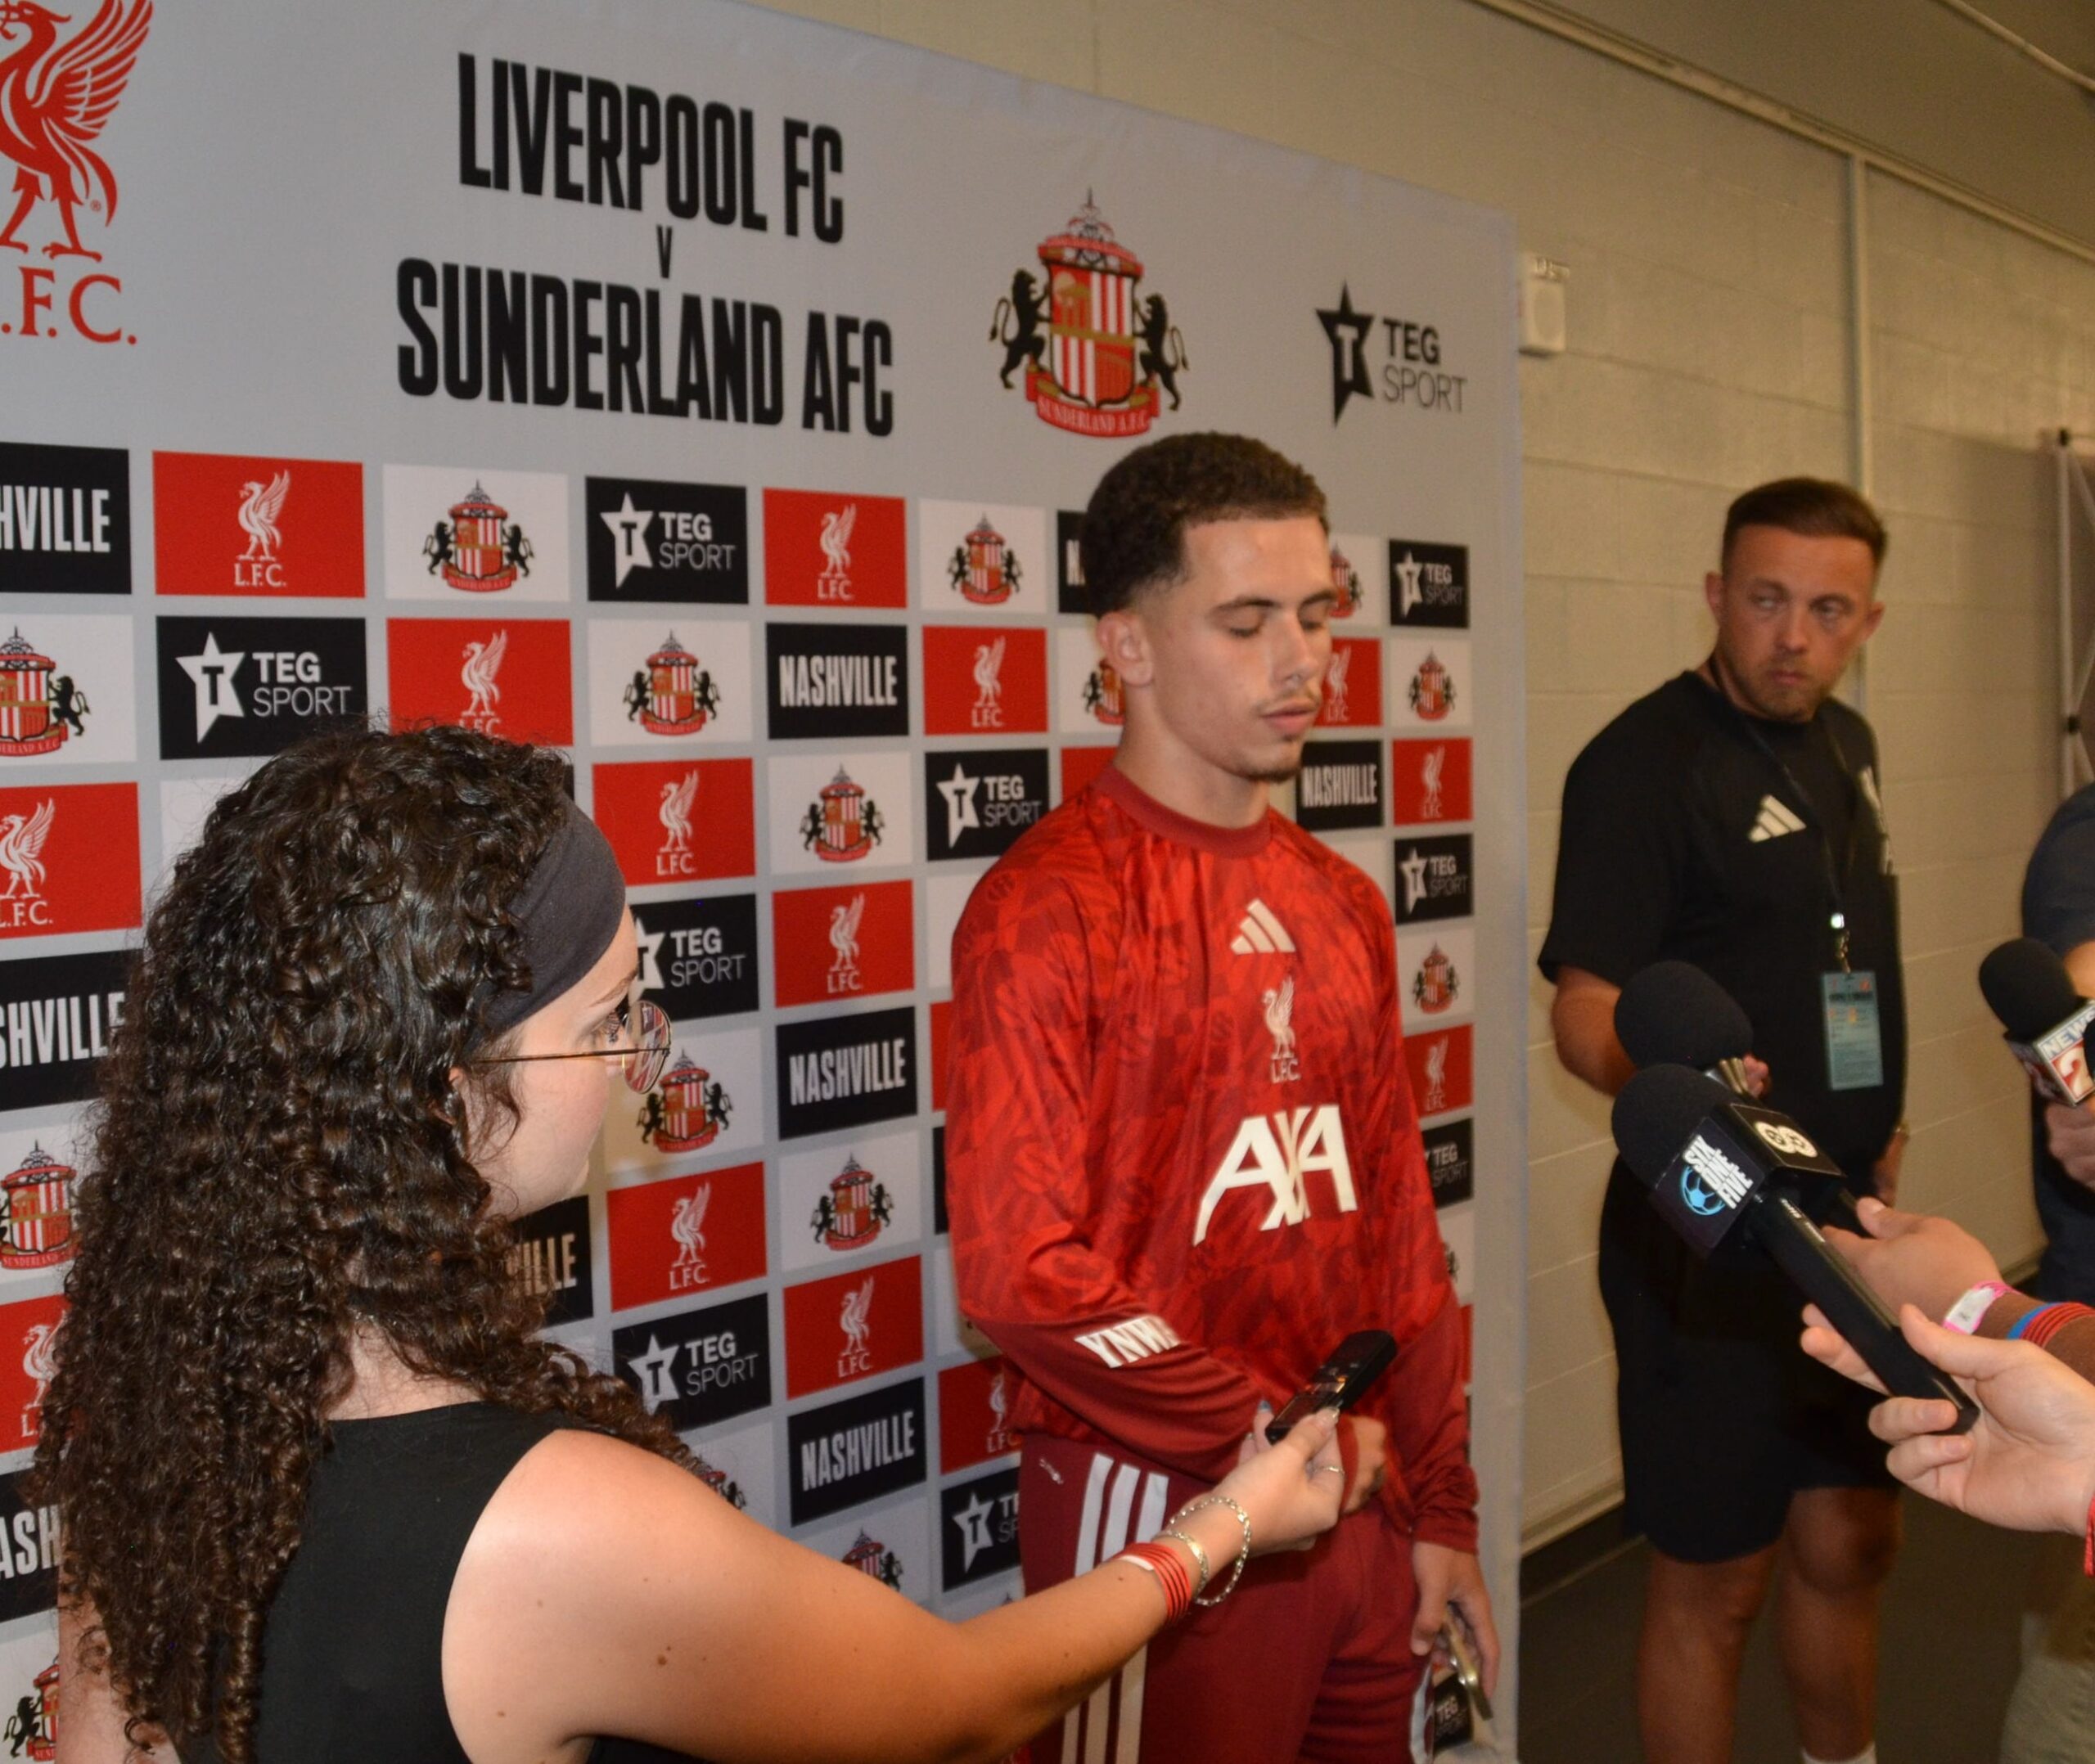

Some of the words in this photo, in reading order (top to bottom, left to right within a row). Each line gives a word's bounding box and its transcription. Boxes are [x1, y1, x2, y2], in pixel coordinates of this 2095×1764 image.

[459, 53, 767, 232] LIVERPOOL
[784, 119, 843, 244] FC
[398, 257, 783, 425] SUNDERLAND
[803, 312, 893, 437] AFC
[1382, 317, 1439, 366] TEG
[1383, 365, 1467, 412] SPORT
[659, 512, 712, 541] TEG
[660, 542, 735, 569] SPORT
[1426, 564, 1452, 583] TEG
[1426, 584, 1463, 605] SPORT
[253, 652, 320, 682] TEG
[780, 655, 897, 706] NASHVILLE
[254, 686, 351, 717] SPORT
[984, 776, 1024, 800] TEG
[1301, 764, 1376, 807] NASHVILLE
[984, 799, 1041, 827] SPORT
[1430, 856, 1456, 875] TEG
[1430, 874, 1468, 898] SPORT
[670, 927, 722, 957] TEG
[671, 953, 746, 988] SPORT
[790, 1038, 905, 1105] NASHVILLE
[1434, 1144, 1457, 1164] TEG
[1682, 1134, 1717, 1174] SIX
[1700, 1147, 1736, 1191] ONE
[1194, 1105, 1357, 1244] AXA
[1715, 1164, 1755, 1209] FIVE
[685, 1332, 736, 1366] TEG
[687, 1353, 758, 1396] SPORT
[801, 1411, 915, 1491] NASHVILLE
